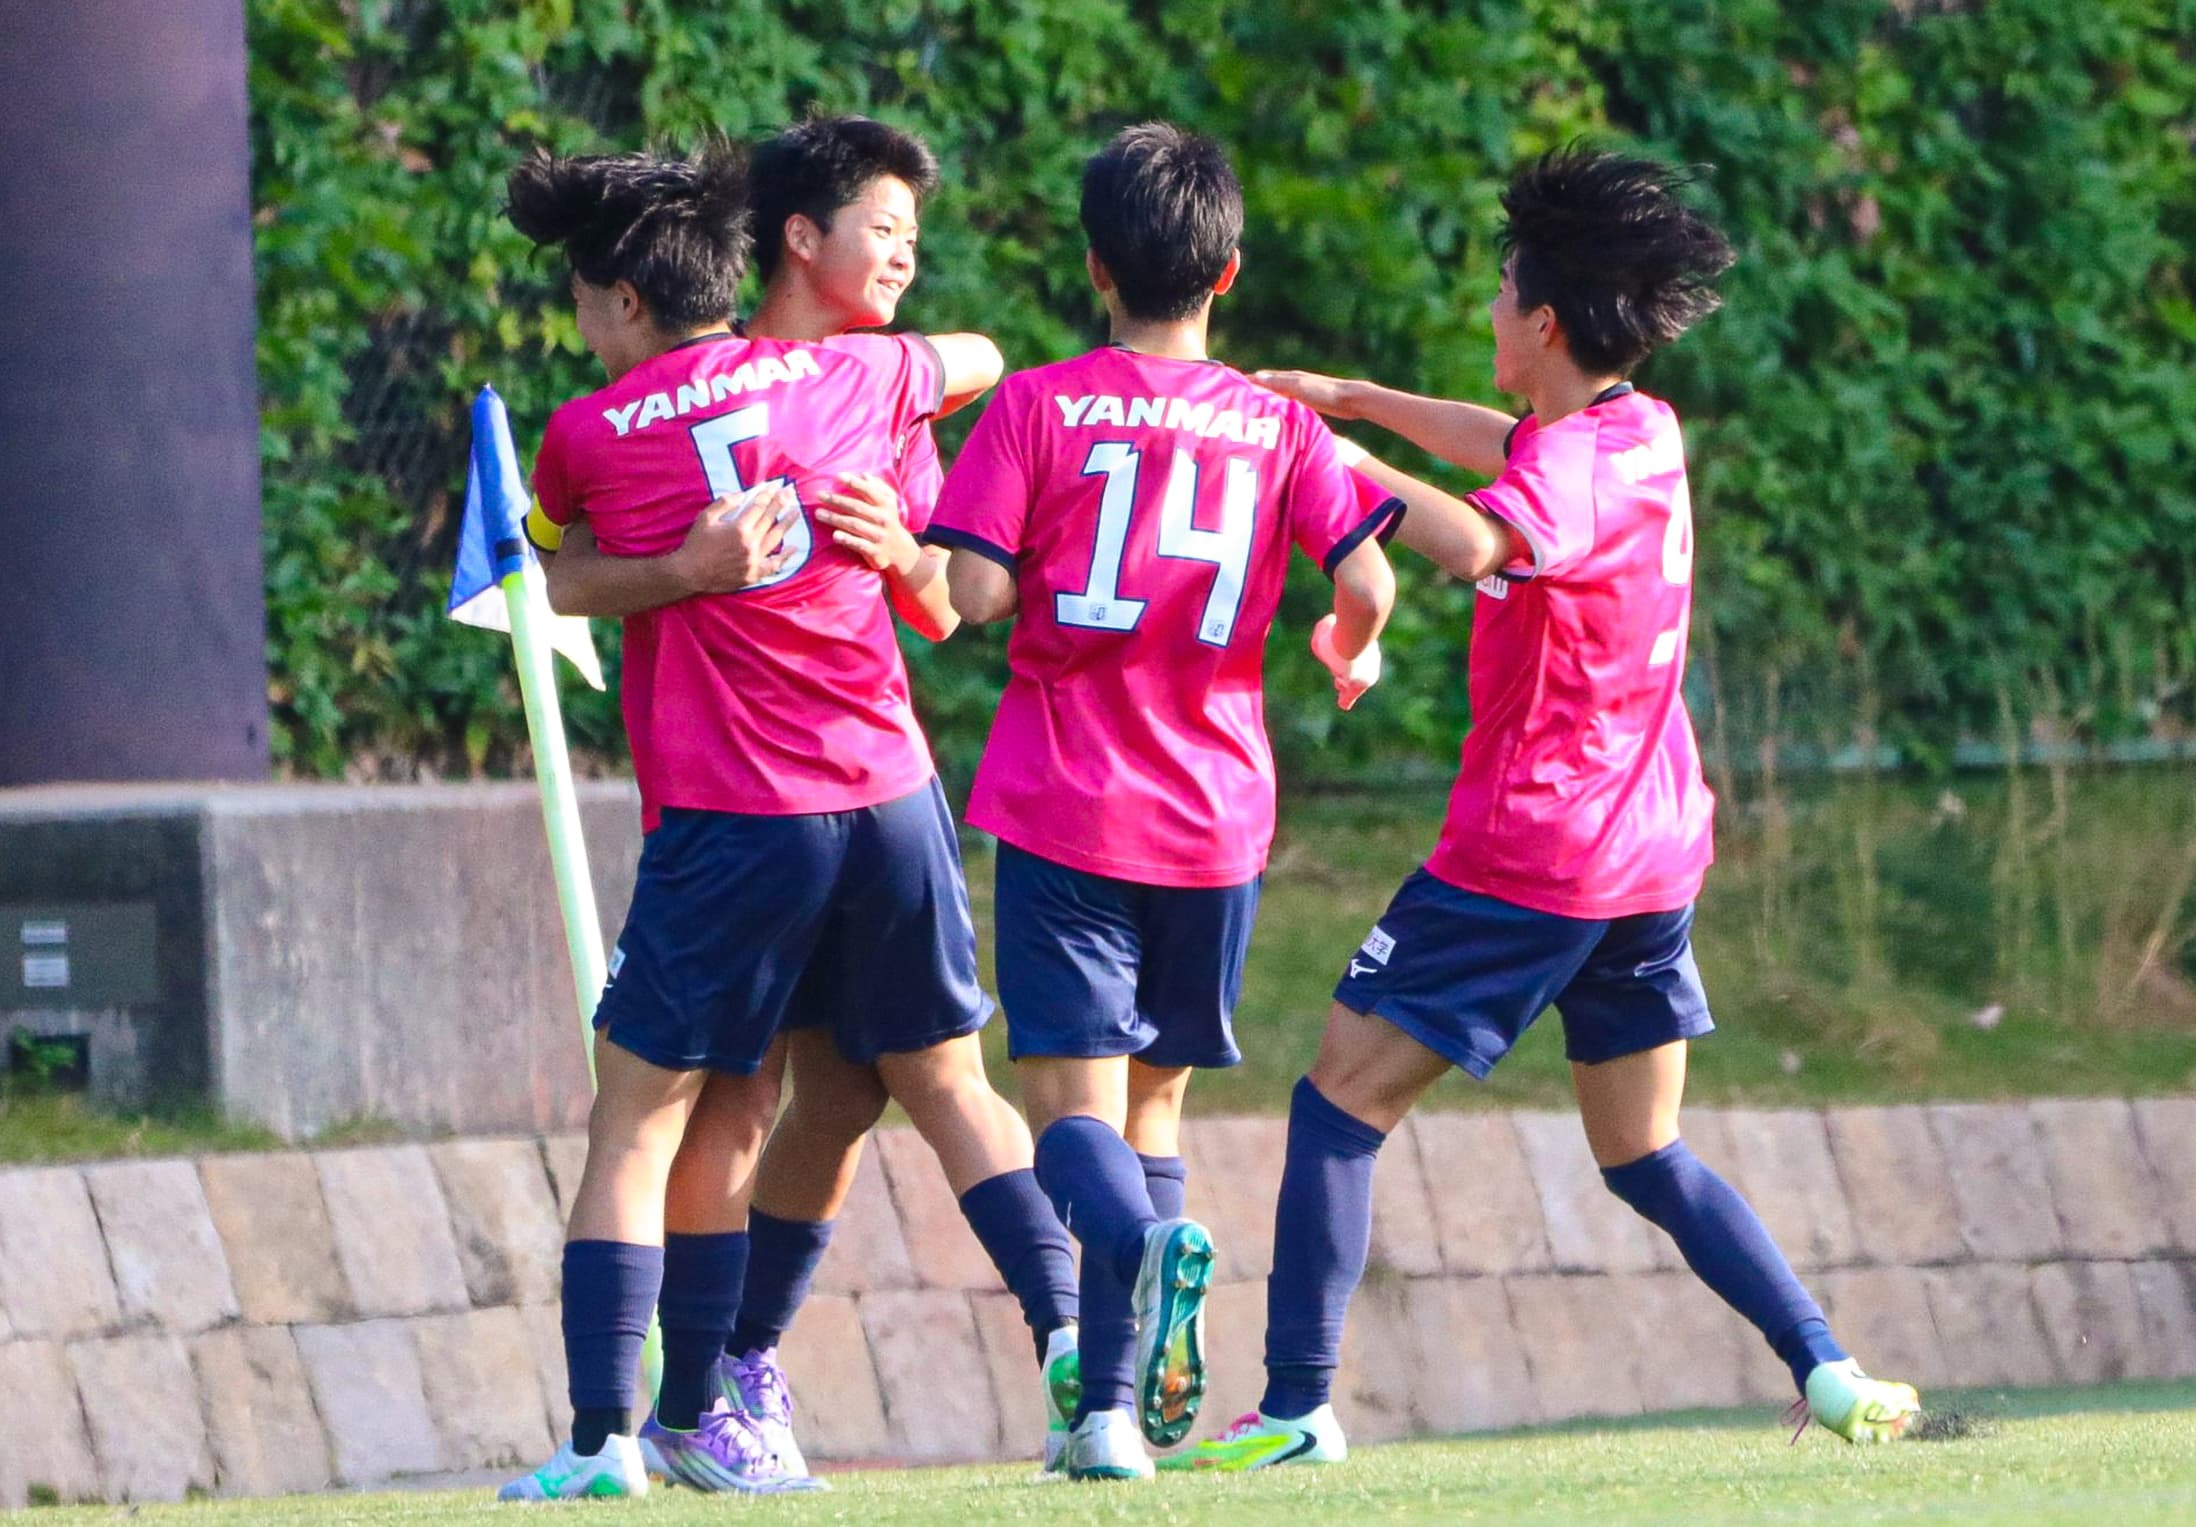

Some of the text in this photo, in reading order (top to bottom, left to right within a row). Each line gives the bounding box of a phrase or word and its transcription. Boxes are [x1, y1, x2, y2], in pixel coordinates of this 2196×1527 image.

[602, 349, 820, 436] YANMAR
[1054, 395, 1281, 450] YANMAR
[1054, 440, 1260, 649] 14
